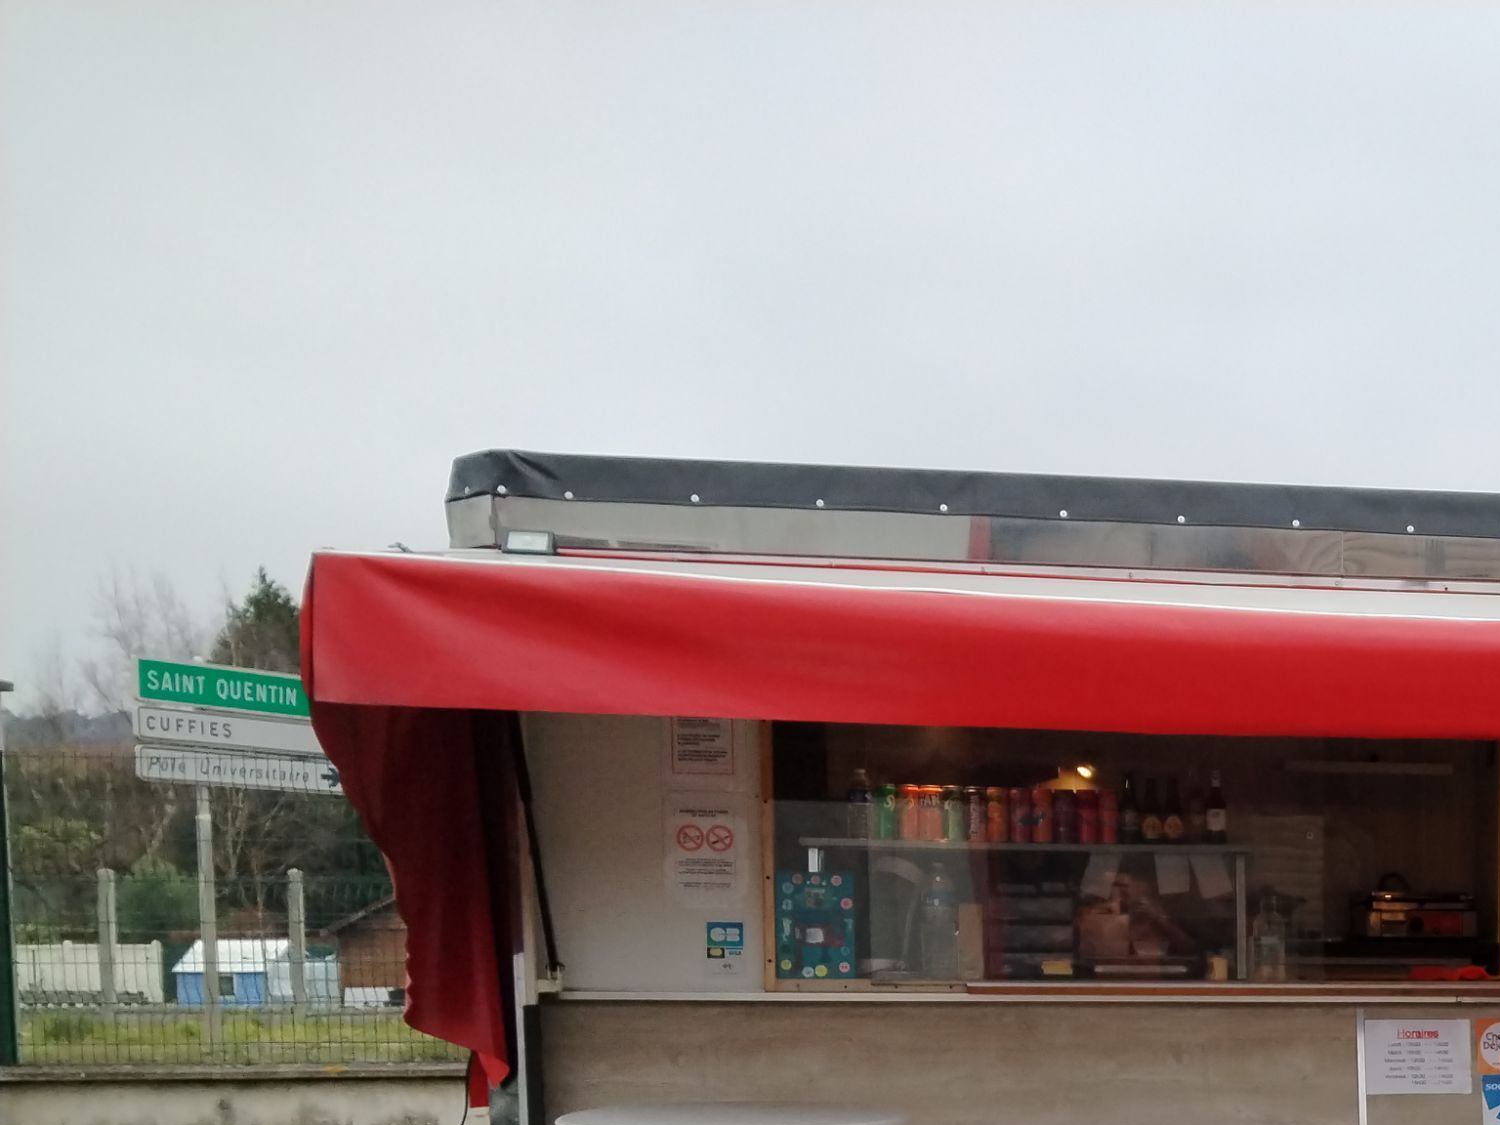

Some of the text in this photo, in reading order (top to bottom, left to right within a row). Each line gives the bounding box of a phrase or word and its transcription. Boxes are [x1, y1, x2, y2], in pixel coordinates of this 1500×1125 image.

[147, 669, 297, 707] SAINT QUENTIN
[146, 715, 233, 738] CUFFIES
[200, 756, 310, 783] Universitaire
[1396, 1028, 1440, 1039] Horaires
